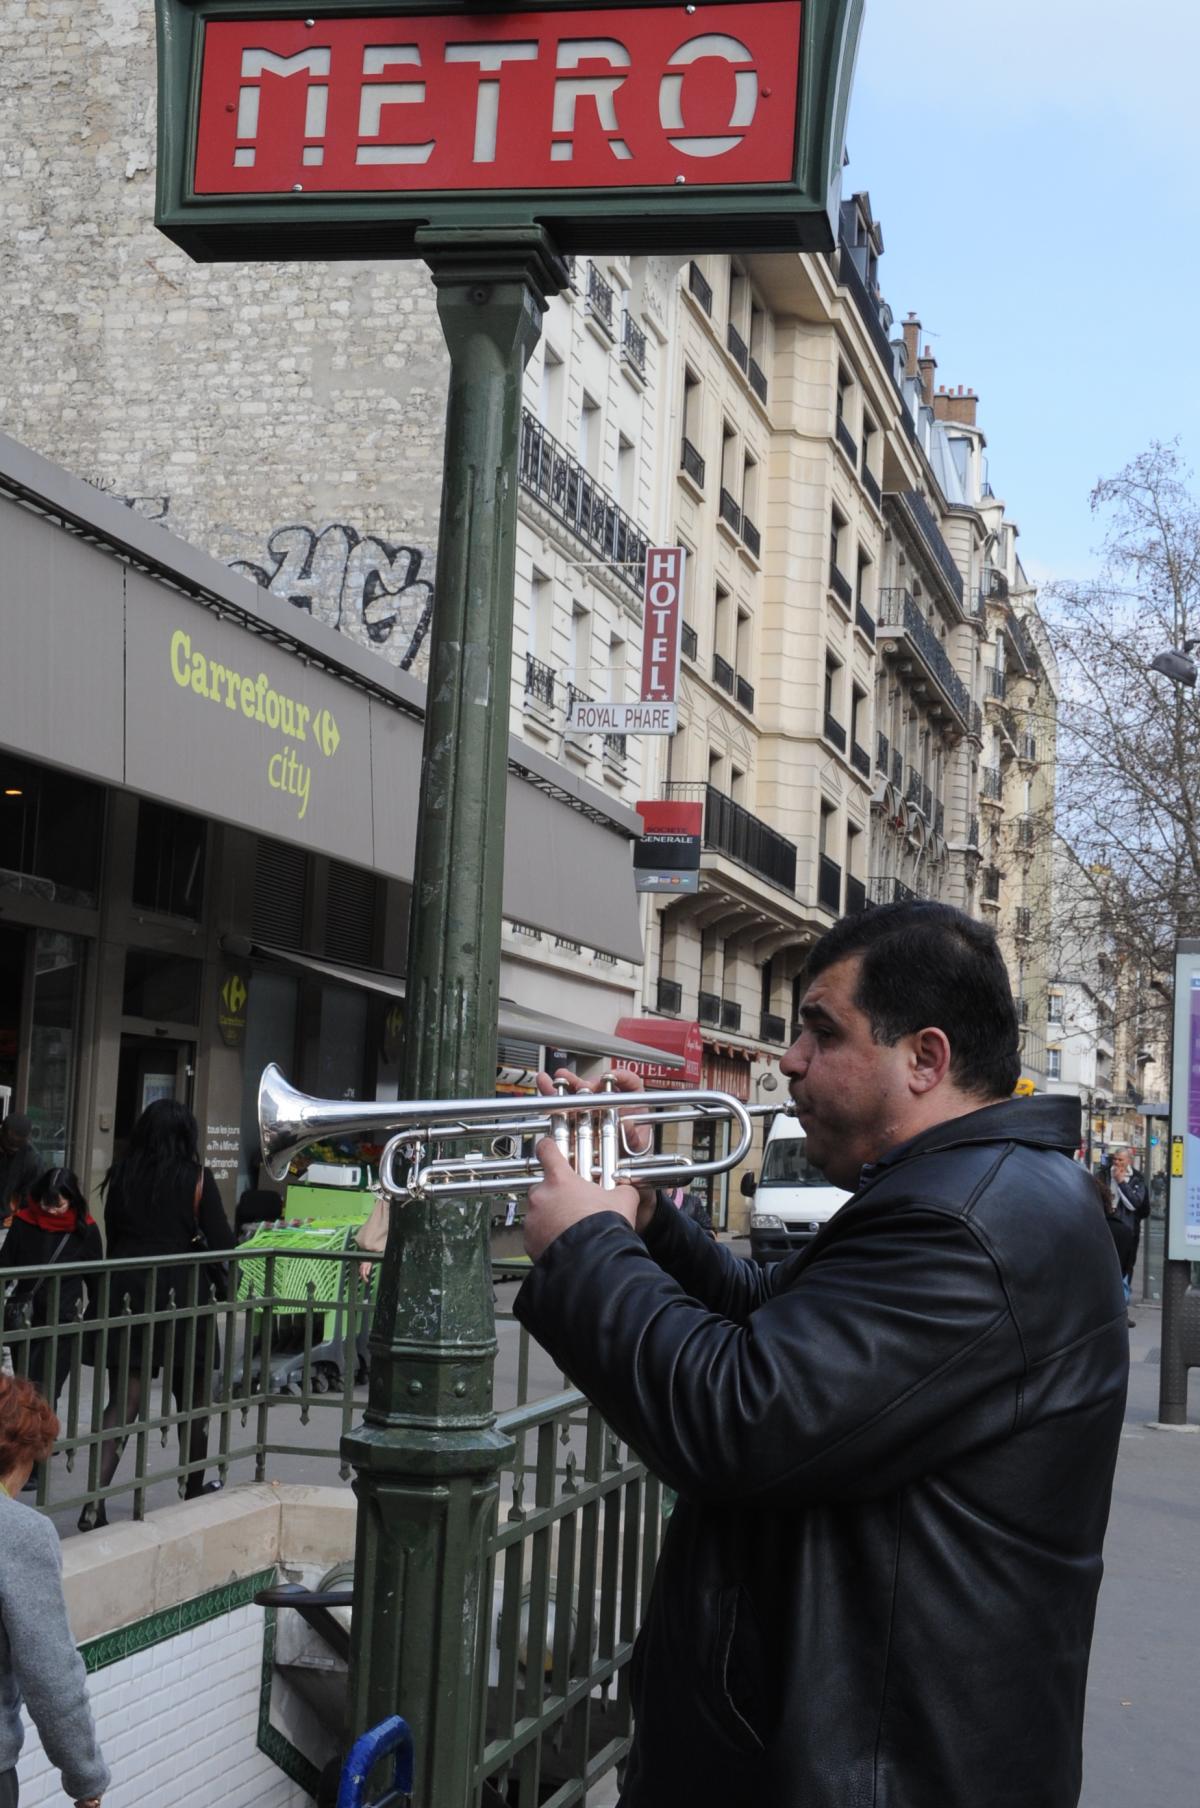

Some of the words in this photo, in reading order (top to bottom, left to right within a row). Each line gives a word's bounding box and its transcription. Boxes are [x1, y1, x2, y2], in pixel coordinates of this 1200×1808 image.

[232, 32, 758, 168] METRO
[649, 554, 676, 690] HOTEL
[171, 630, 310, 741] Carrefour
[577, 707, 619, 728] ROYAL
[624, 708, 670, 729] PHARE
[268, 746, 311, 819] city
[616, 1060, 667, 1078] HOTEL
